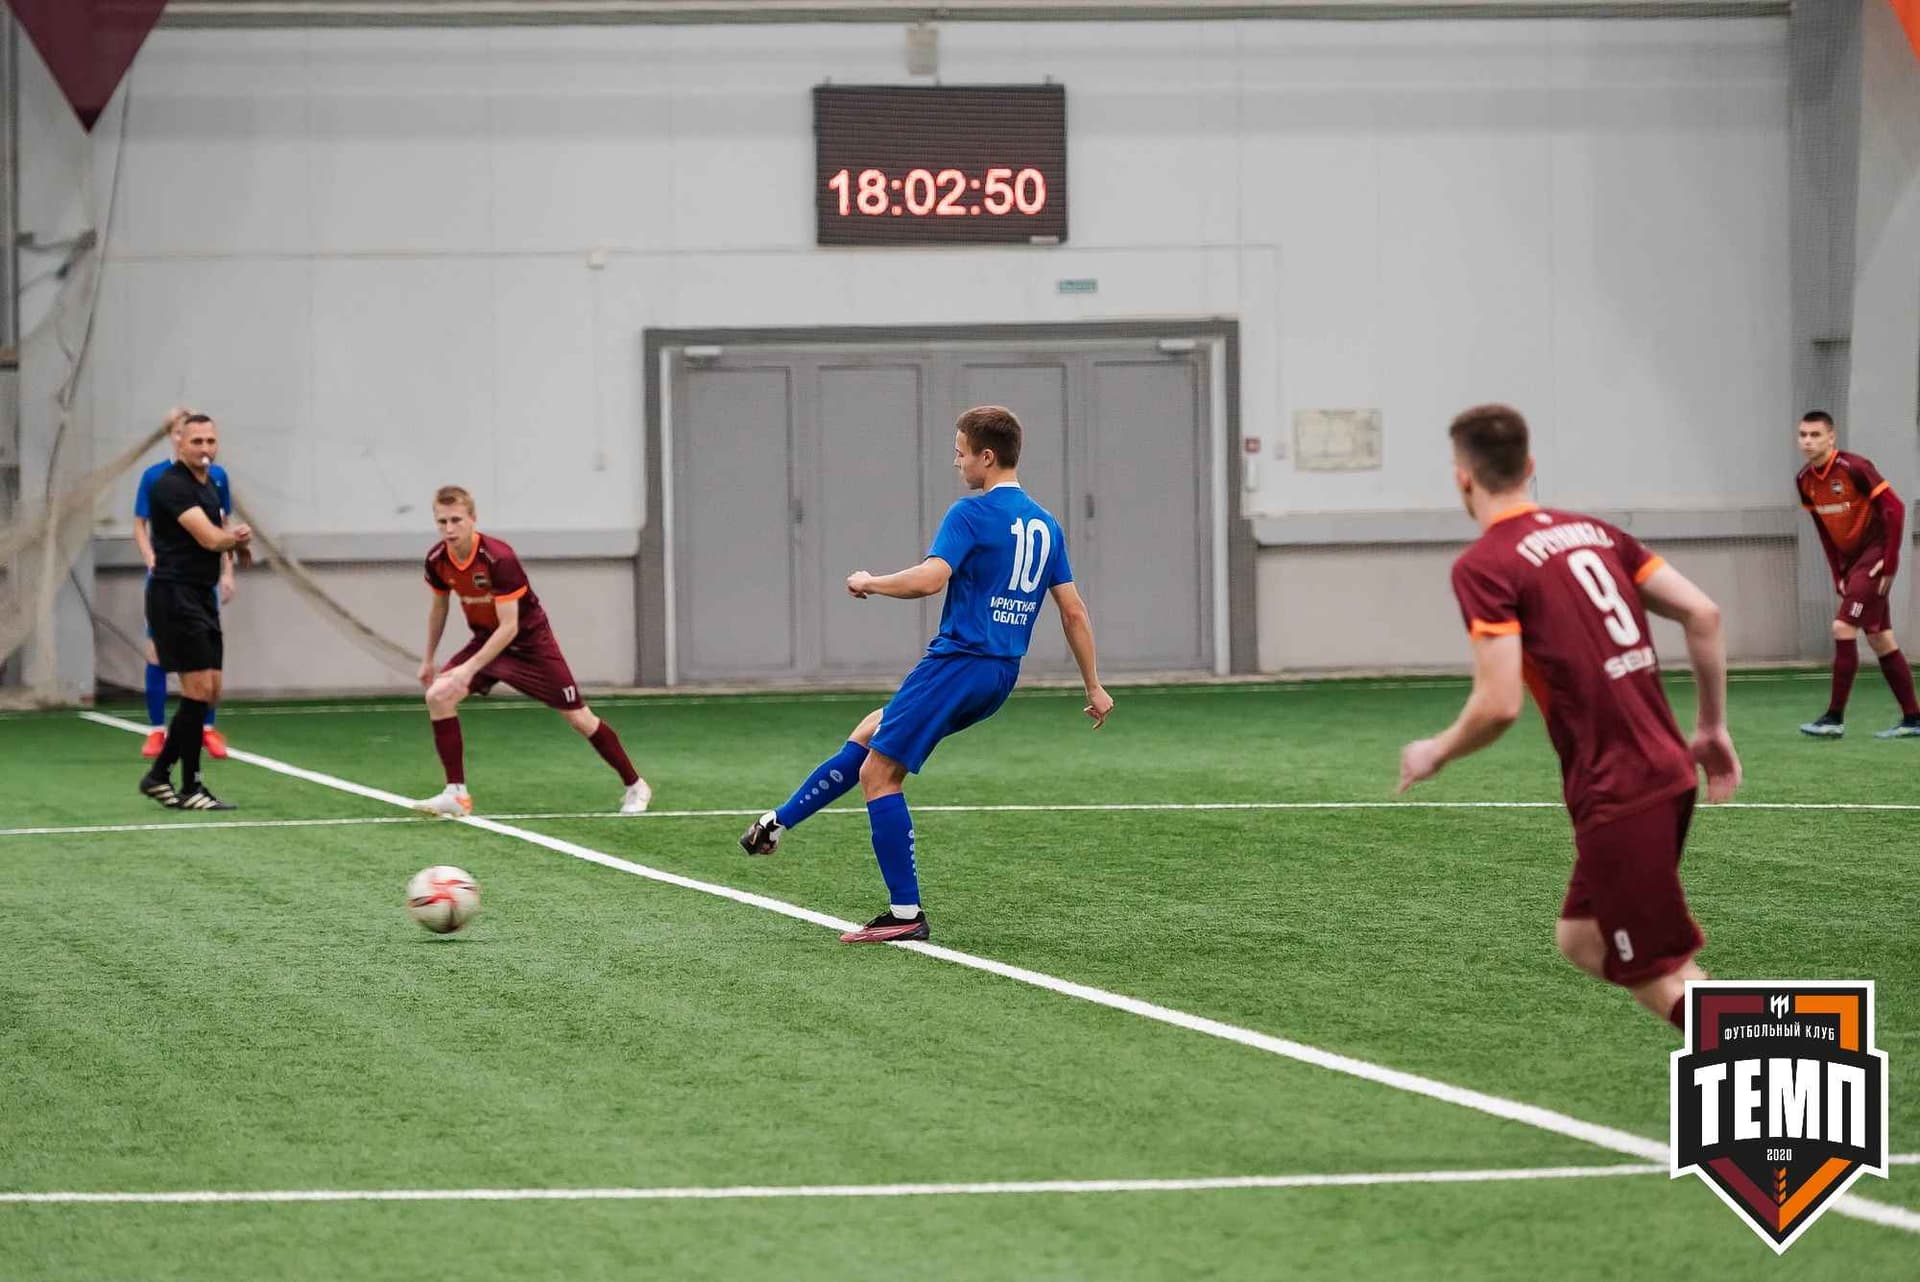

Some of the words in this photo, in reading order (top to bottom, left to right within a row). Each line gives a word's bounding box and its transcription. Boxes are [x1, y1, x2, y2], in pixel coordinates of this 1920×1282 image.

[828, 168, 1047, 217] 18:02:50
[1008, 517, 1051, 594] 10
[990, 596, 1037, 613] ИРКУТКАЯ
[1566, 549, 1641, 647] 9
[1613, 929, 1635, 962] 9
